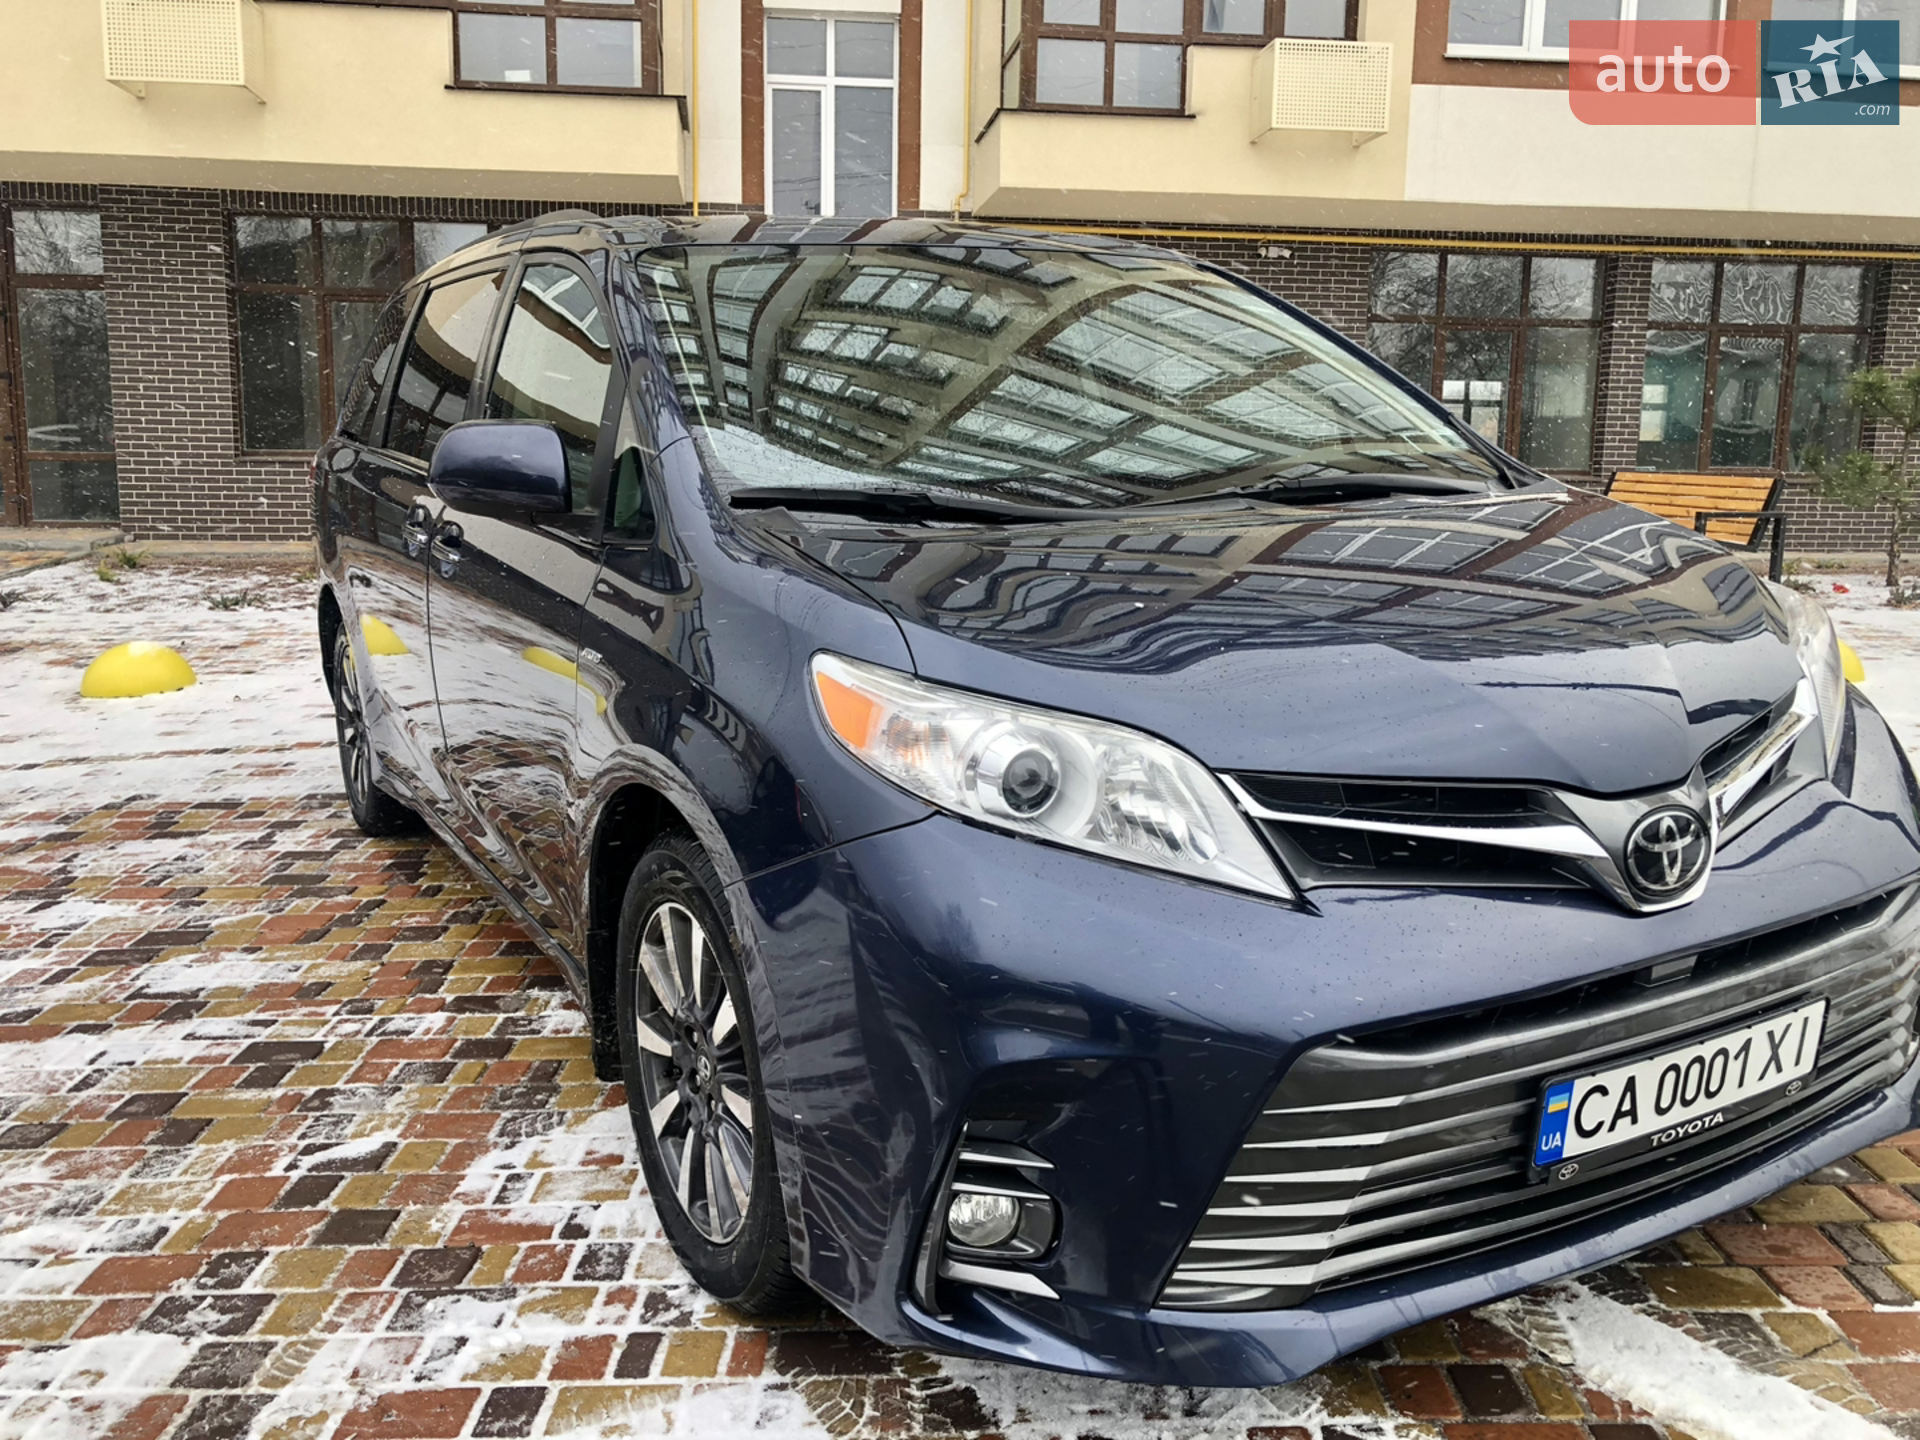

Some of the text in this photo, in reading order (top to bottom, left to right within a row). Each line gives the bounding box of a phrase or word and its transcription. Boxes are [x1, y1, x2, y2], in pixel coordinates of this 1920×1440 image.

[1573, 1015, 1810, 1139] CA 0001 XI
[1541, 1131, 1562, 1151] UA
[1650, 1112, 1724, 1147] TOYOTA
